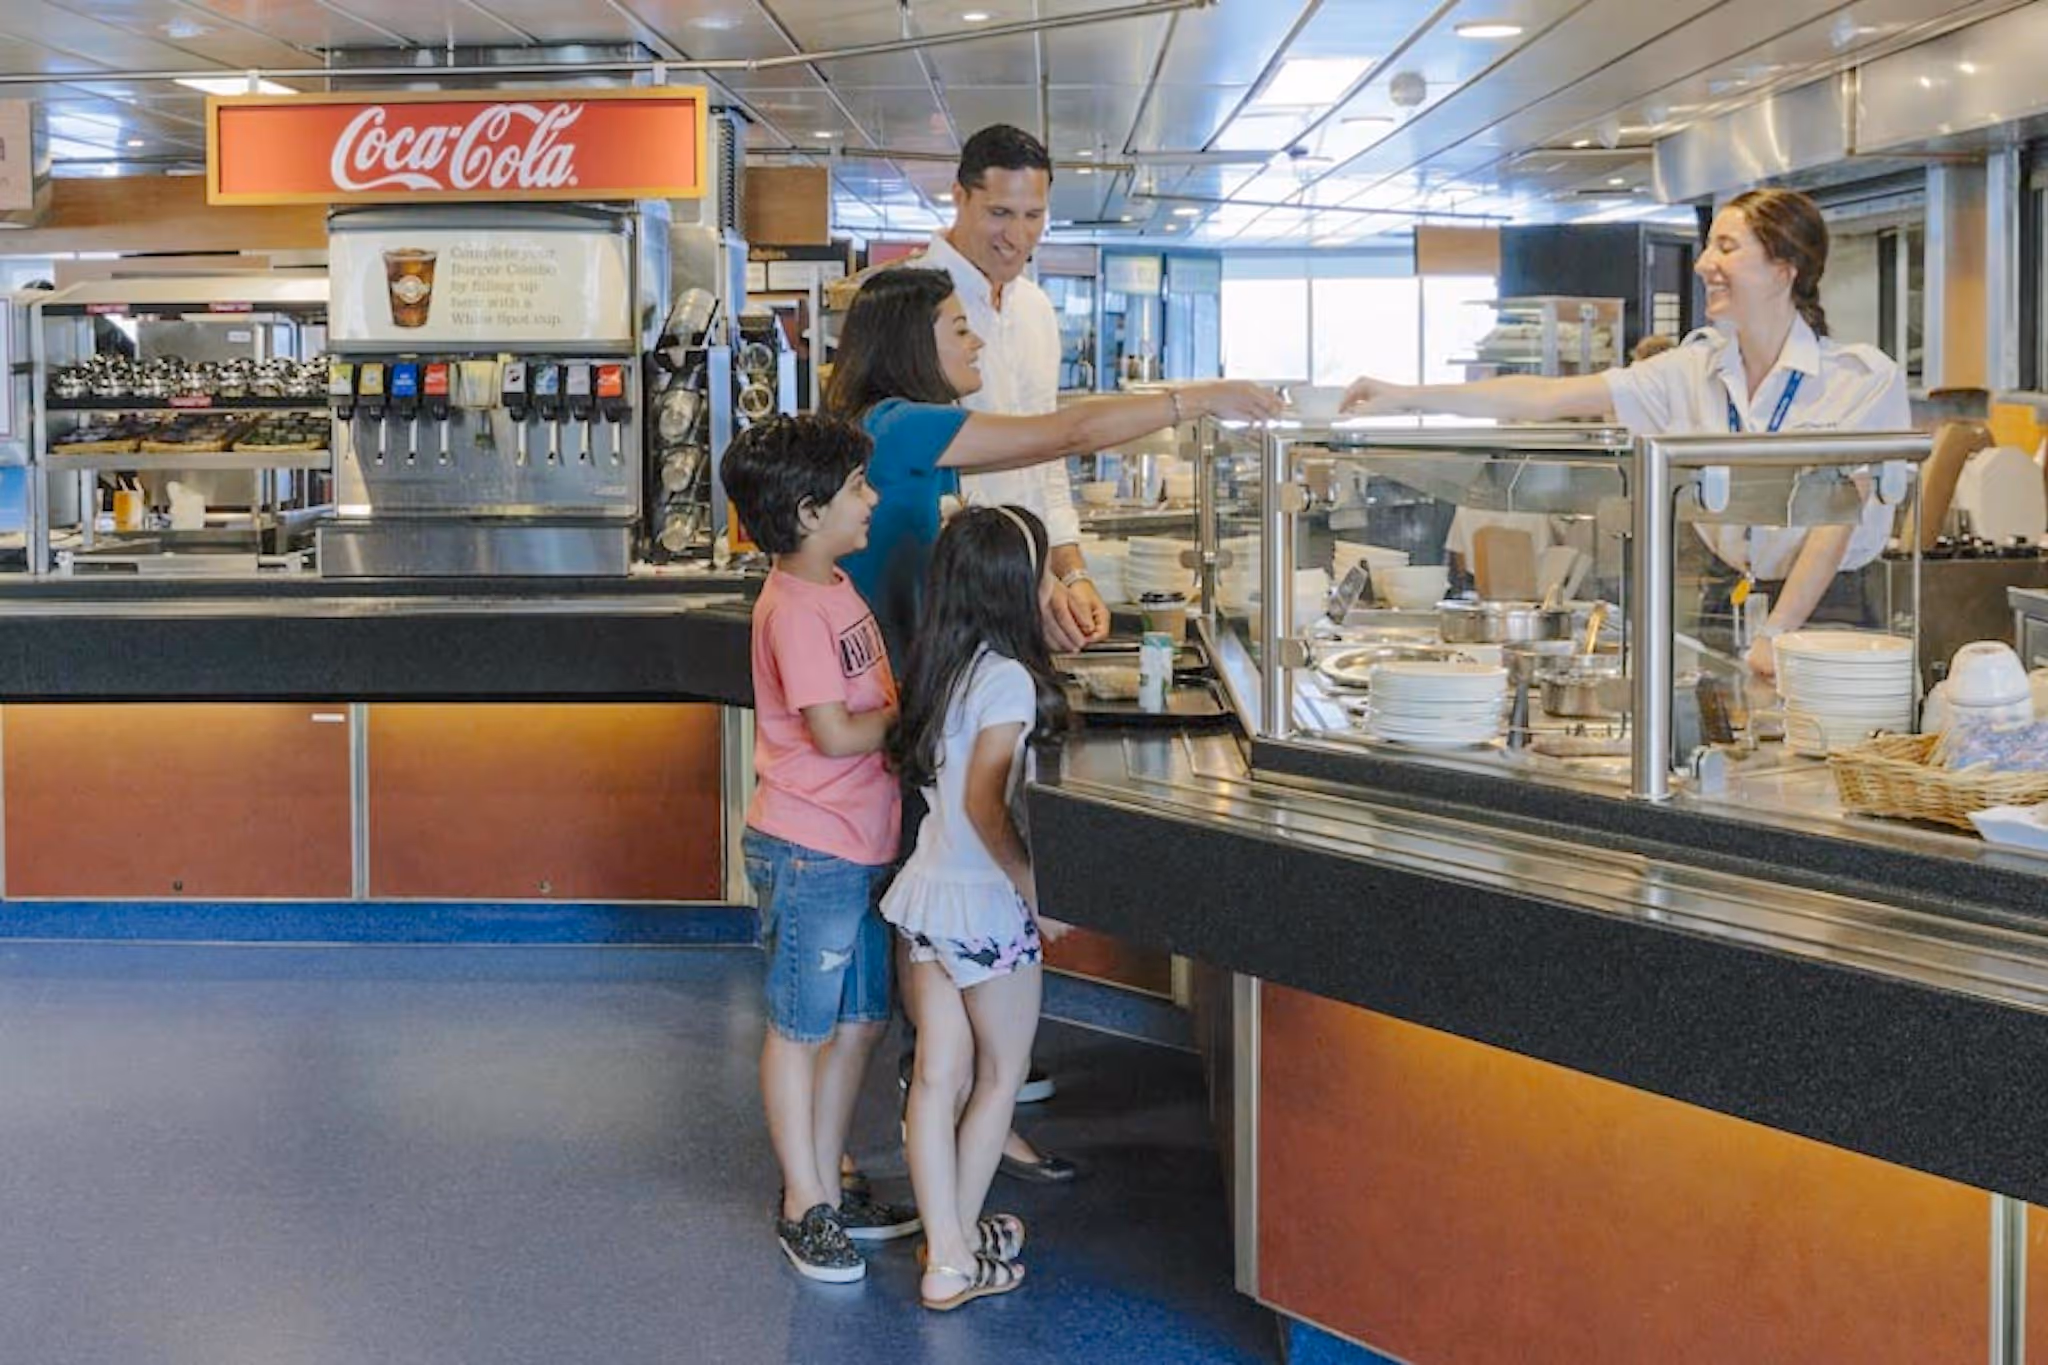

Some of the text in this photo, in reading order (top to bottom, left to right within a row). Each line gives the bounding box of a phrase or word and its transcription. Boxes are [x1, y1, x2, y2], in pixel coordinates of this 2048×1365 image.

[331, 102, 584, 191] Coca-Cola
[449, 246, 519, 261] Complete
[451, 263, 558, 277] Burger Combo
[449, 280, 539, 294] by filling up
[487, 297, 520, 308] with
[523, 300, 533, 309] a
[497, 312, 529, 327] Spot
